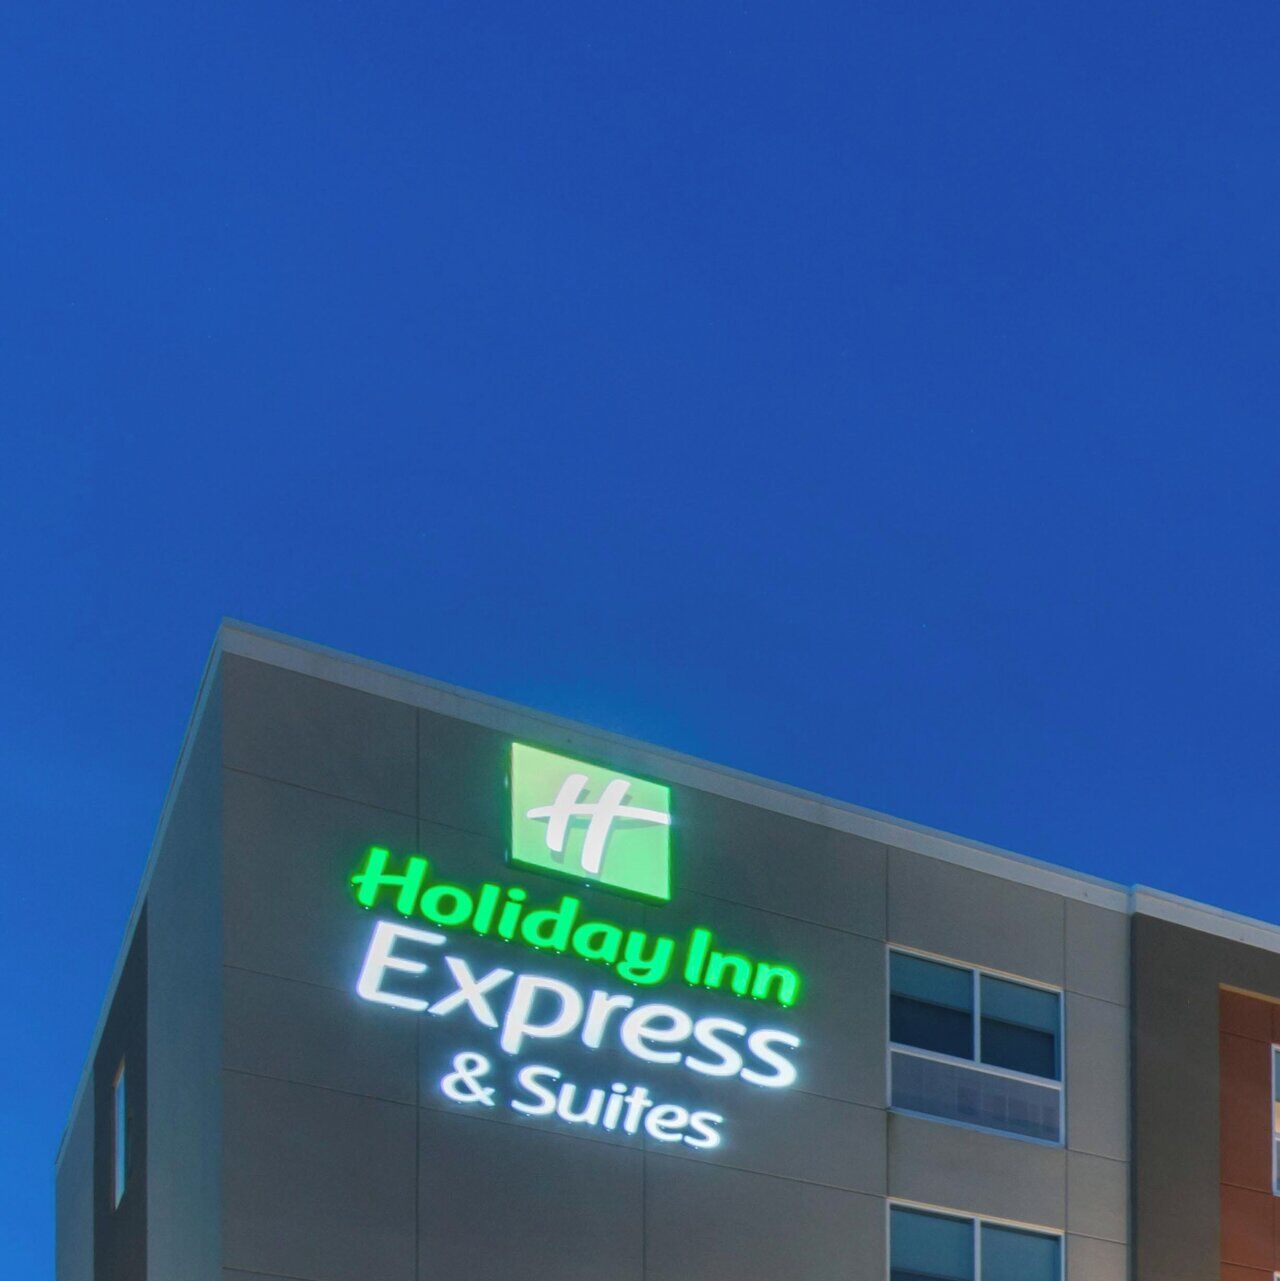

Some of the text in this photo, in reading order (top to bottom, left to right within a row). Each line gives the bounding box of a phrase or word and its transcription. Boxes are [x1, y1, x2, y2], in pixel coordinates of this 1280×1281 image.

[526, 774, 671, 873] H
[351, 848, 799, 1006] Holiday Inn
[356, 921, 801, 1088] Express
[441, 1052, 723, 1149] & Suites
